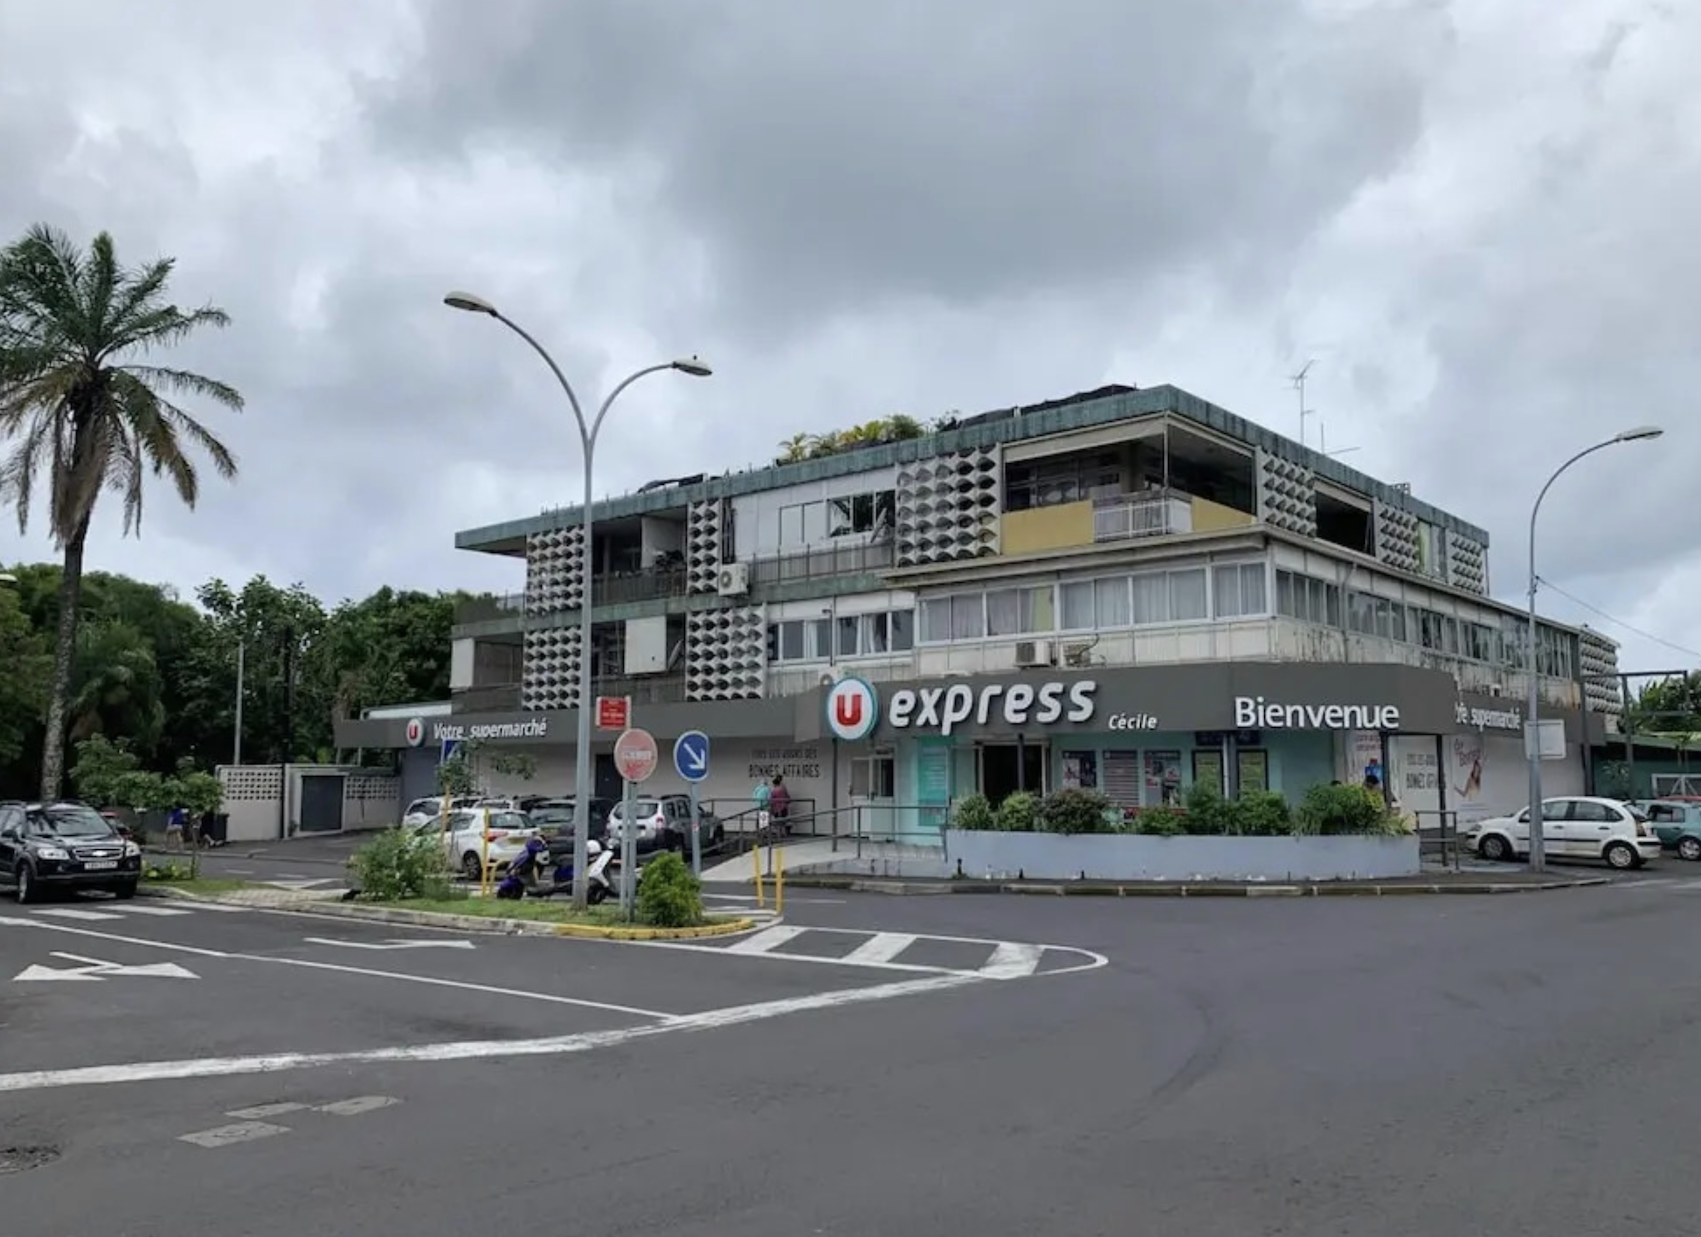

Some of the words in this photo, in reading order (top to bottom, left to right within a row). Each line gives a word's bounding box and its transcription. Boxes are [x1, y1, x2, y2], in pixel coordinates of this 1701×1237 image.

[836, 694, 863, 727] U
[888, 680, 1098, 736] express
[1234, 696, 1400, 728] Bienvenue
[433, 722, 464, 739] Votre
[469, 717, 547, 739] supermarché
[1108, 710, 1158, 730] Cécile
[749, 764, 780, 778] BONNES
[782, 764, 819, 778] AFFAIRES
